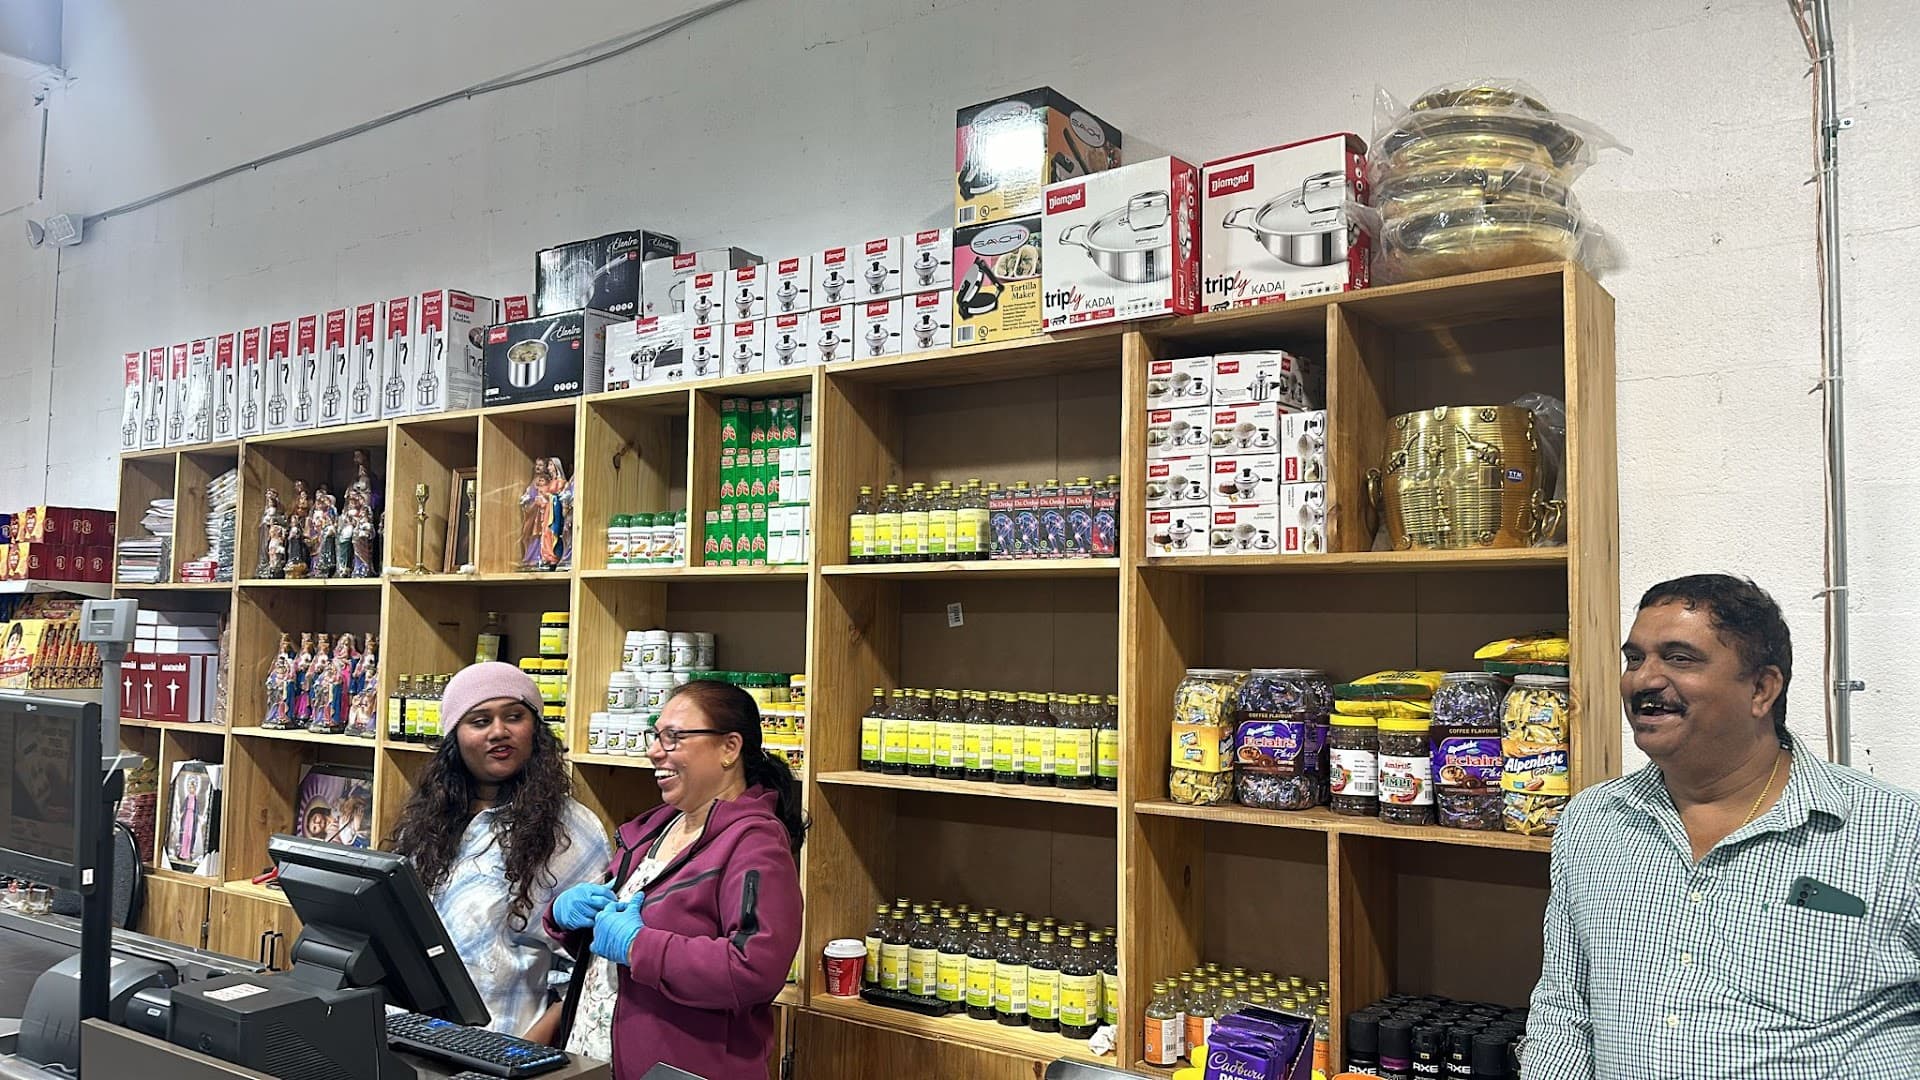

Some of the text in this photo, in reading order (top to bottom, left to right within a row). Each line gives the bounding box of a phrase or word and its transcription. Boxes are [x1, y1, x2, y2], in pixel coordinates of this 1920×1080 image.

[1212, 171, 1249, 192] Diamond
[1049, 190, 1081, 209] Diamond
[973, 234, 1022, 248] SACHI
[1011, 282, 1037, 293] Tortilla
[1205, 270, 1285, 297] triply KADAI
[1012, 291, 1035, 301] Maker
[1045, 286, 1115, 311] triply KADAI
[1243, 736, 1297, 749] Eclairs
[1445, 754, 1503, 767] Eclairs
[1505, 753, 1564, 773] Alpenliebe
[1532, 765, 1554, 777] Gold
[1208, 1050, 1266, 1079] Cadbury
[1348, 1064, 1377, 1076] AXE
[1413, 1062, 1439, 1074] AXE
[1446, 1062, 1471, 1074] AXE
